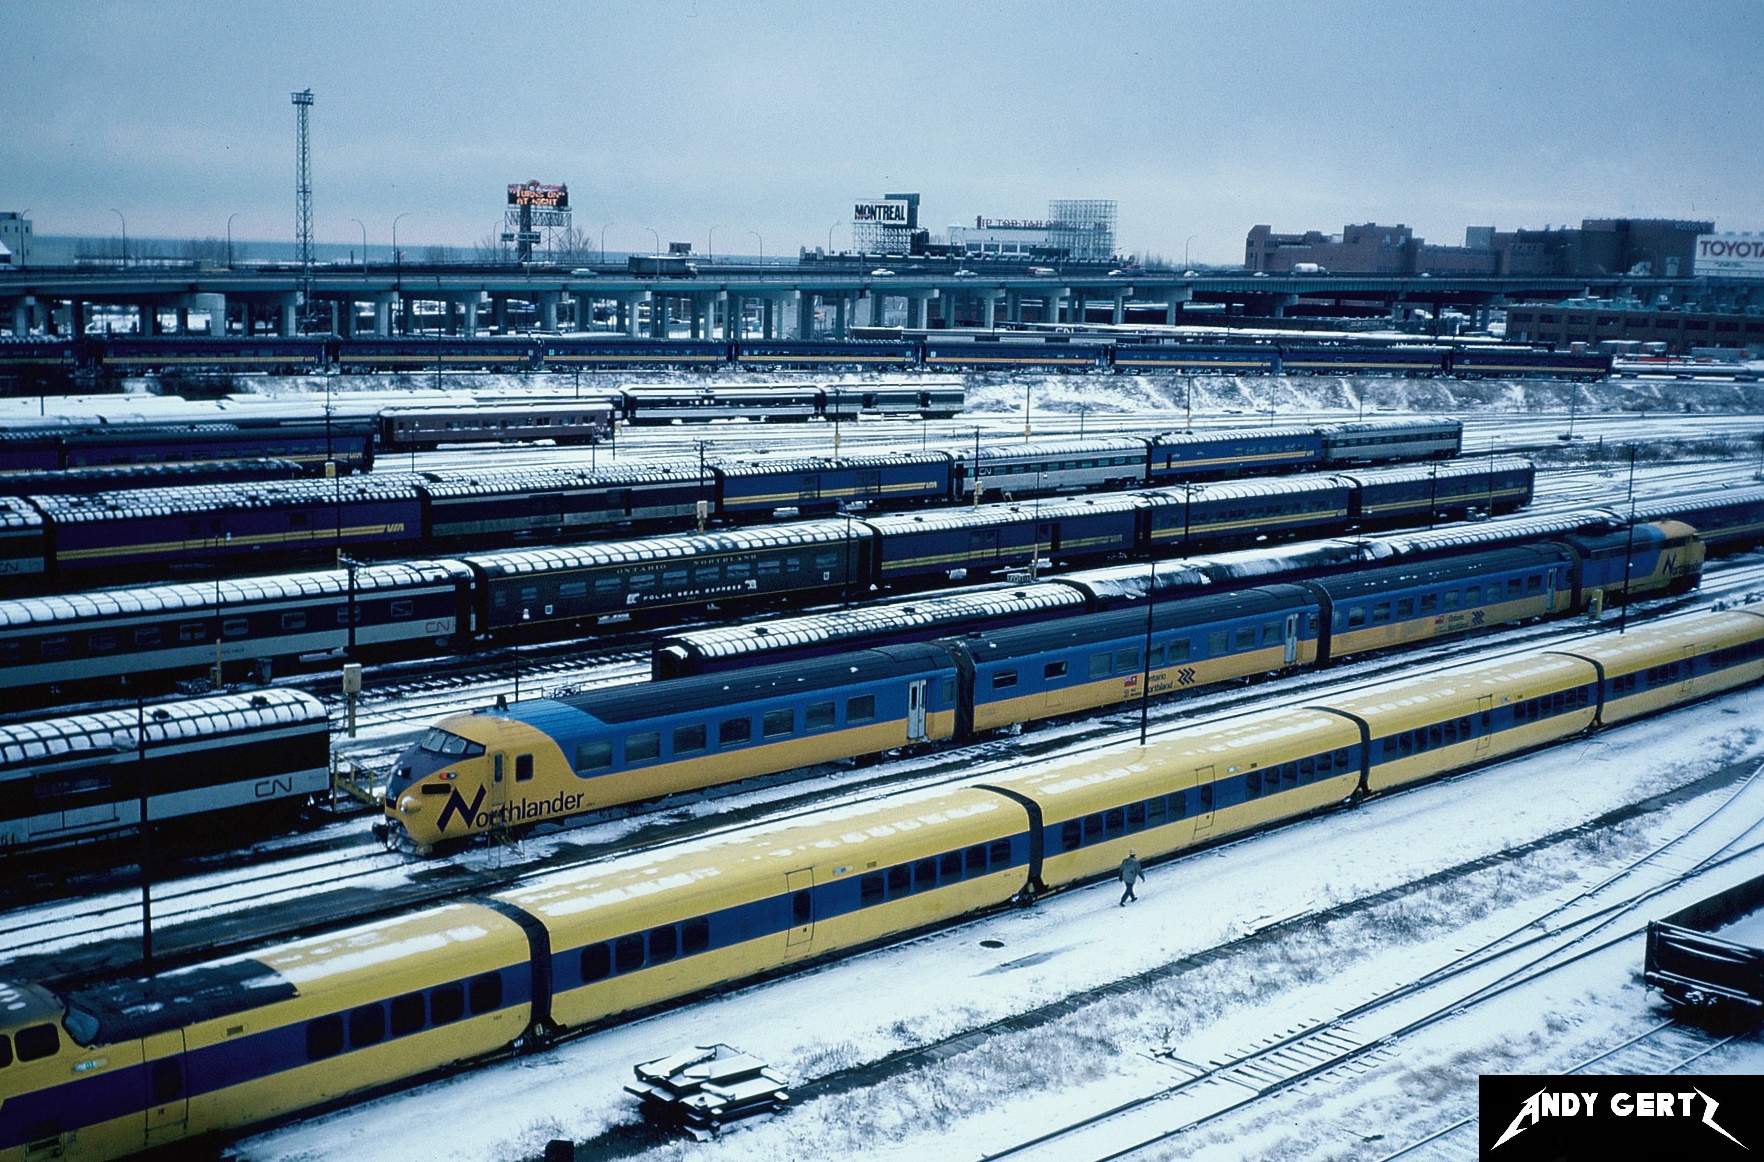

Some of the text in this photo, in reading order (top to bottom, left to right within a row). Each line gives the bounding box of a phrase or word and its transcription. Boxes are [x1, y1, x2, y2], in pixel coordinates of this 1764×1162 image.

[516, 197, 557, 206] AT NIGHT
[854, 204, 905, 221] MONTREAL
[995, 219, 1018, 228] TOP
[1700, 240, 1764, 258] TOYOT
[979, 467, 992, 475] CN
[387, 523, 404, 532] VIA
[616, 554, 757, 575] ONTARIO NORTHLAND
[643, 584, 742, 601] POLAR BEAR EXPRESS
[425, 620, 449, 633] CN
[1149, 673, 1166, 682] ntario
[1148, 680, 1173, 693] orthland
[254, 777, 293, 798] CN
[436, 783, 585, 833] Northlander
